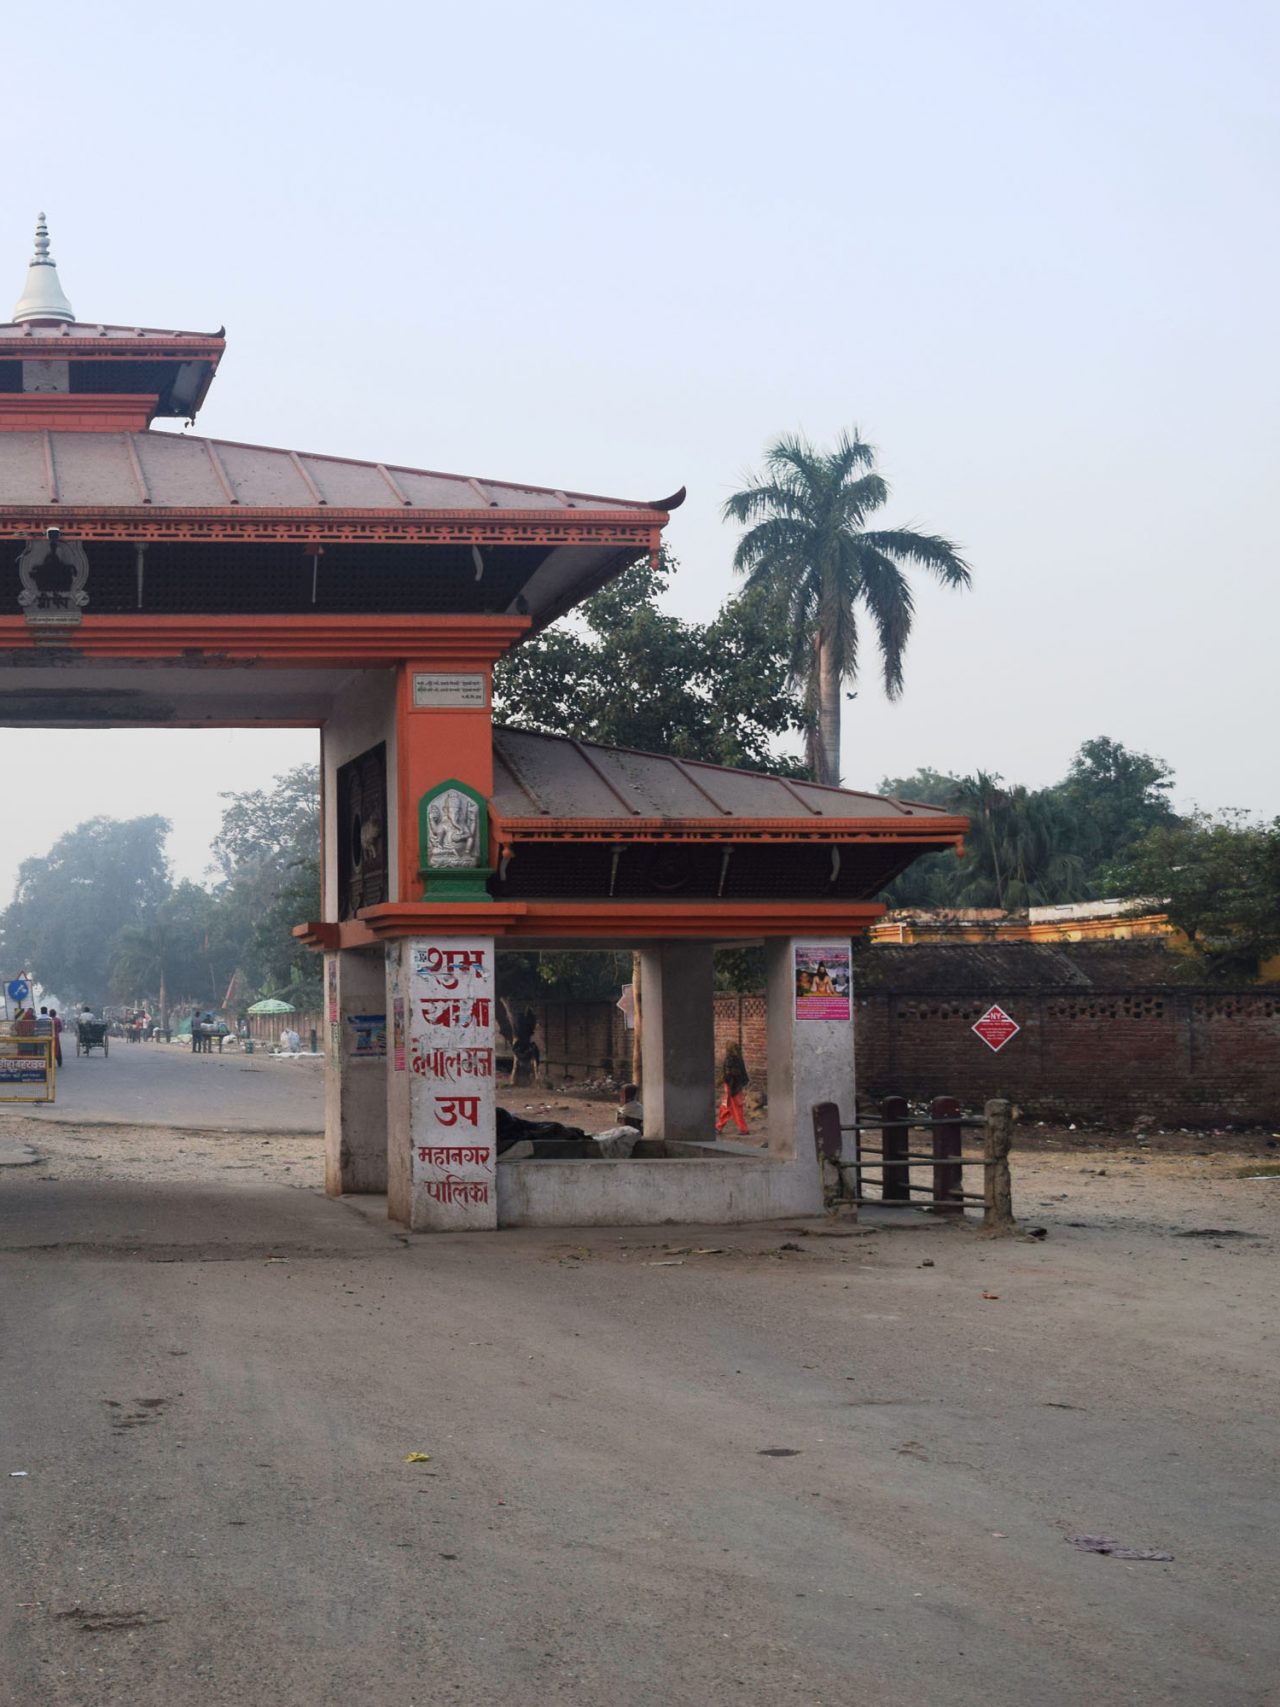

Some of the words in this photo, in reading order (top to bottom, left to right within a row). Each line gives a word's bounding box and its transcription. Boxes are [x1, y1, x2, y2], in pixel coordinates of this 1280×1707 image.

[427, 947, 485, 989] शुभ
[434, 1097, 481, 1127] उप
[418, 1147, 492, 1173] महानगर
[424, 1175, 489, 1211] पालिका
